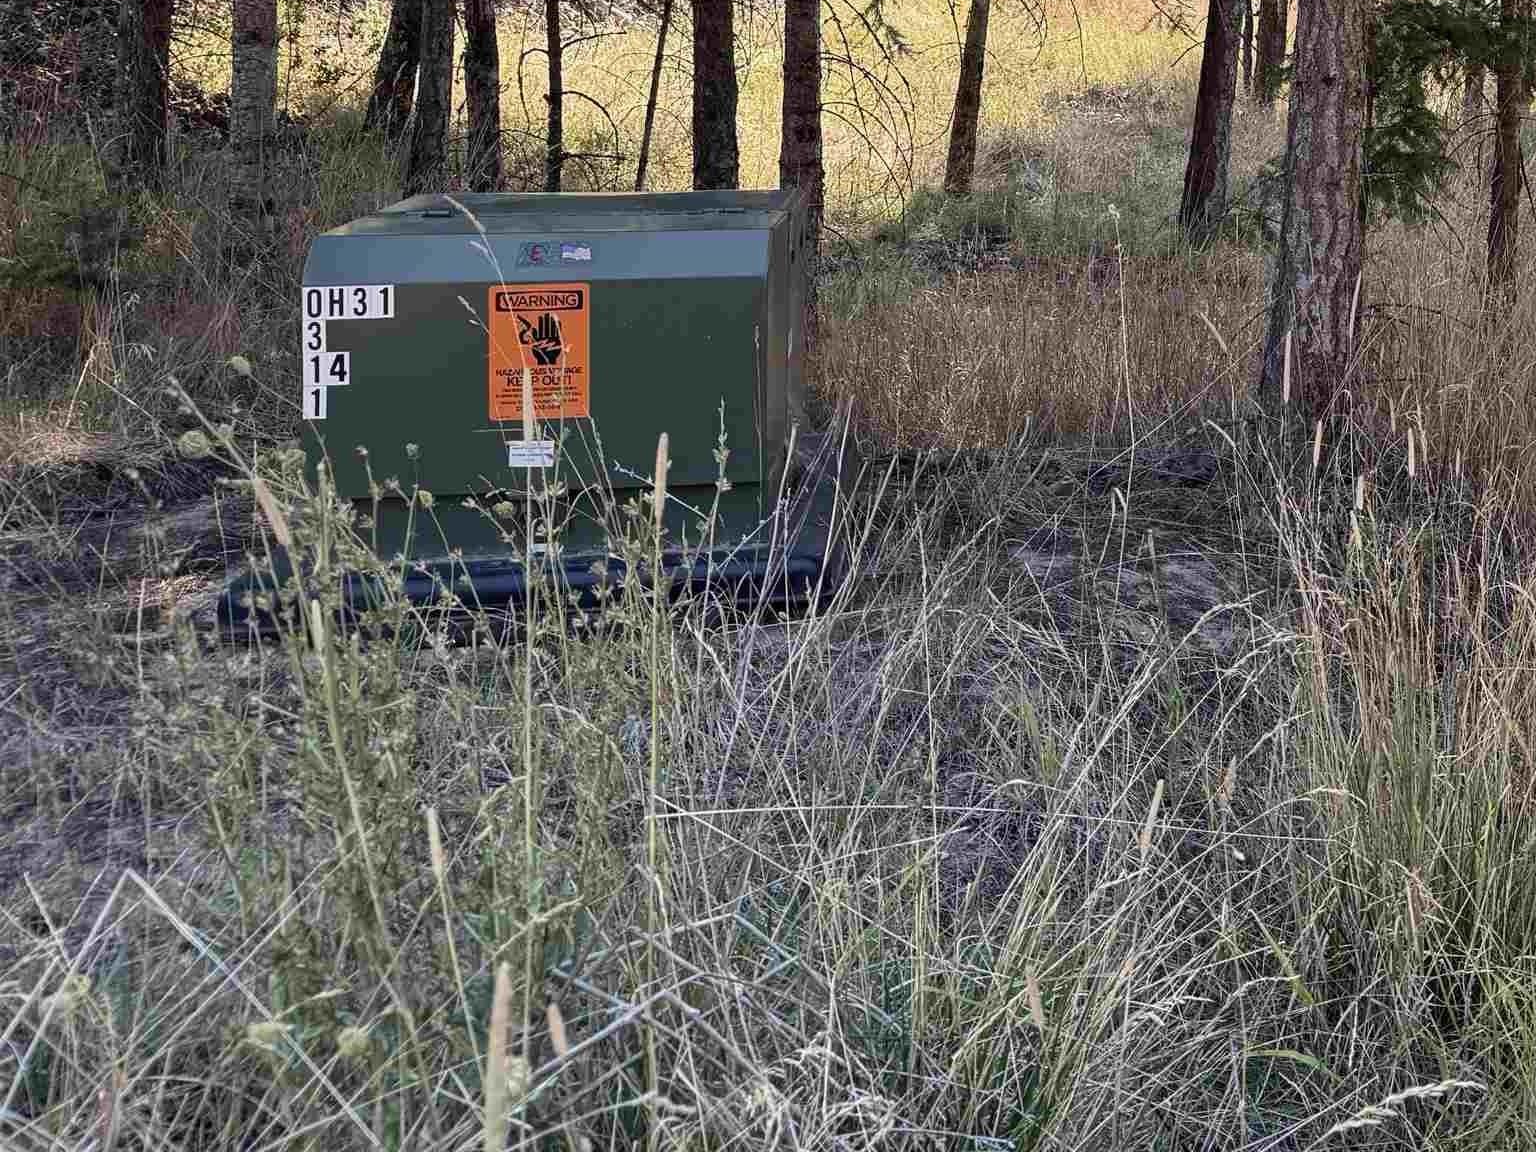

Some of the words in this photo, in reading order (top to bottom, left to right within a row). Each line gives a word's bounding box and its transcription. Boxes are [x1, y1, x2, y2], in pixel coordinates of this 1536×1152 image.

[501, 294, 578, 307] WARNING
[307, 321, 322, 351] 3
[310, 353, 347, 384] 14
[506, 376, 540, 387] KEP
[311, 388, 321, 417] 1
